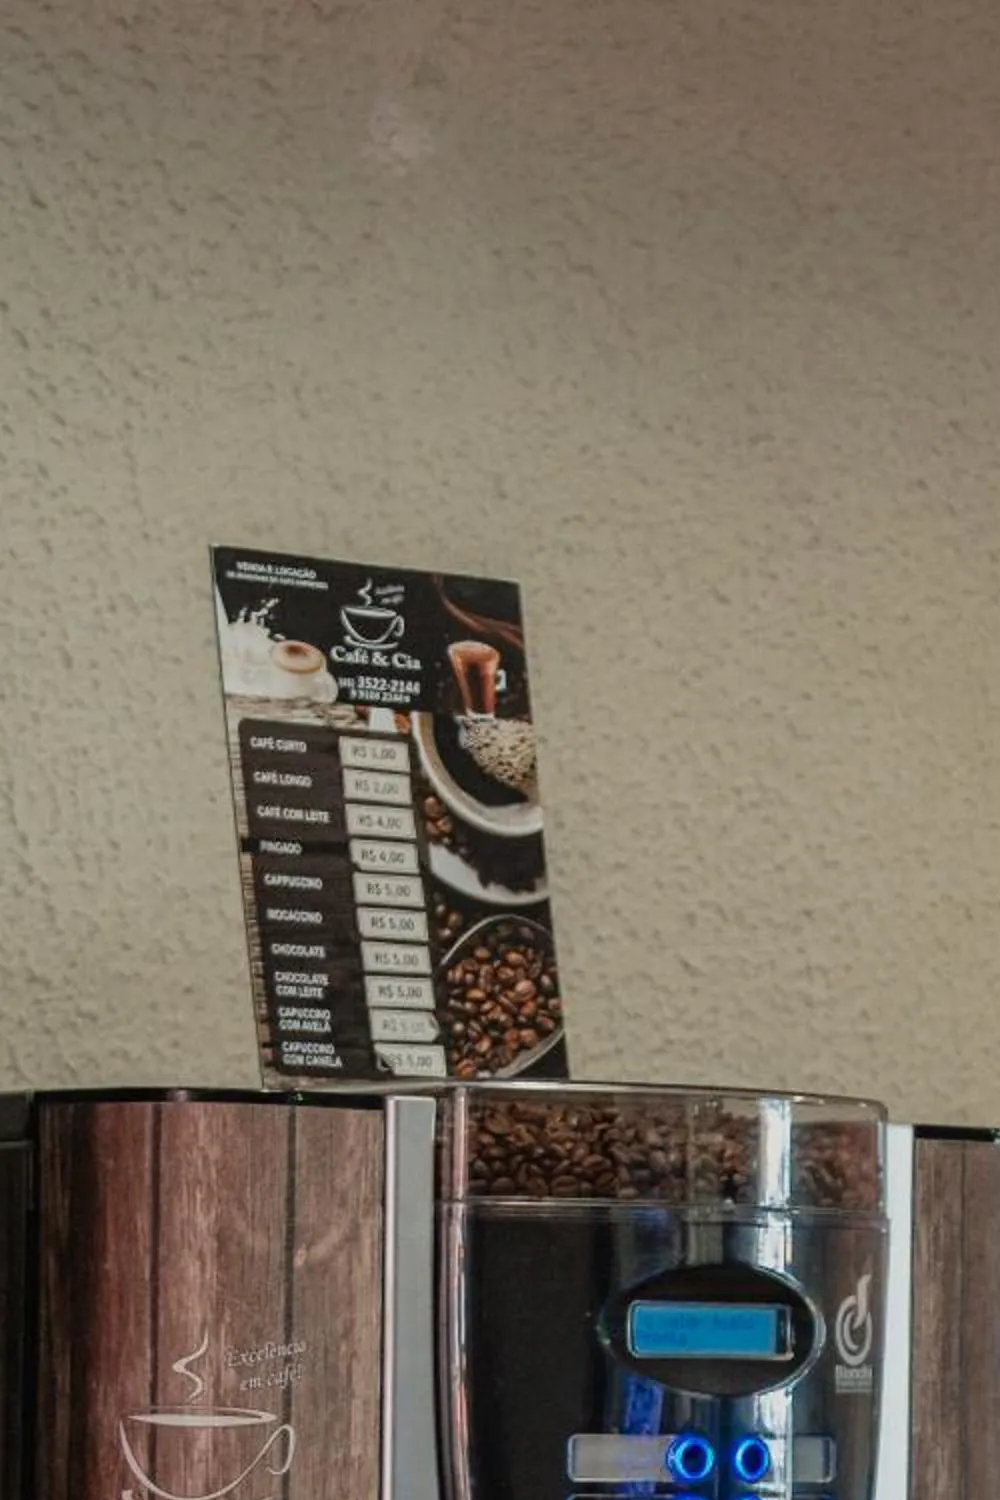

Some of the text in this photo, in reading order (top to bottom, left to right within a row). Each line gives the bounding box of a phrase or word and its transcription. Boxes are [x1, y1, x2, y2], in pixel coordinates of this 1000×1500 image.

[330, 646, 422, 671] Café & Cia
[280, 774, 312, 788] LONGO
[271, 943, 326, 958] CHOCOLATE
